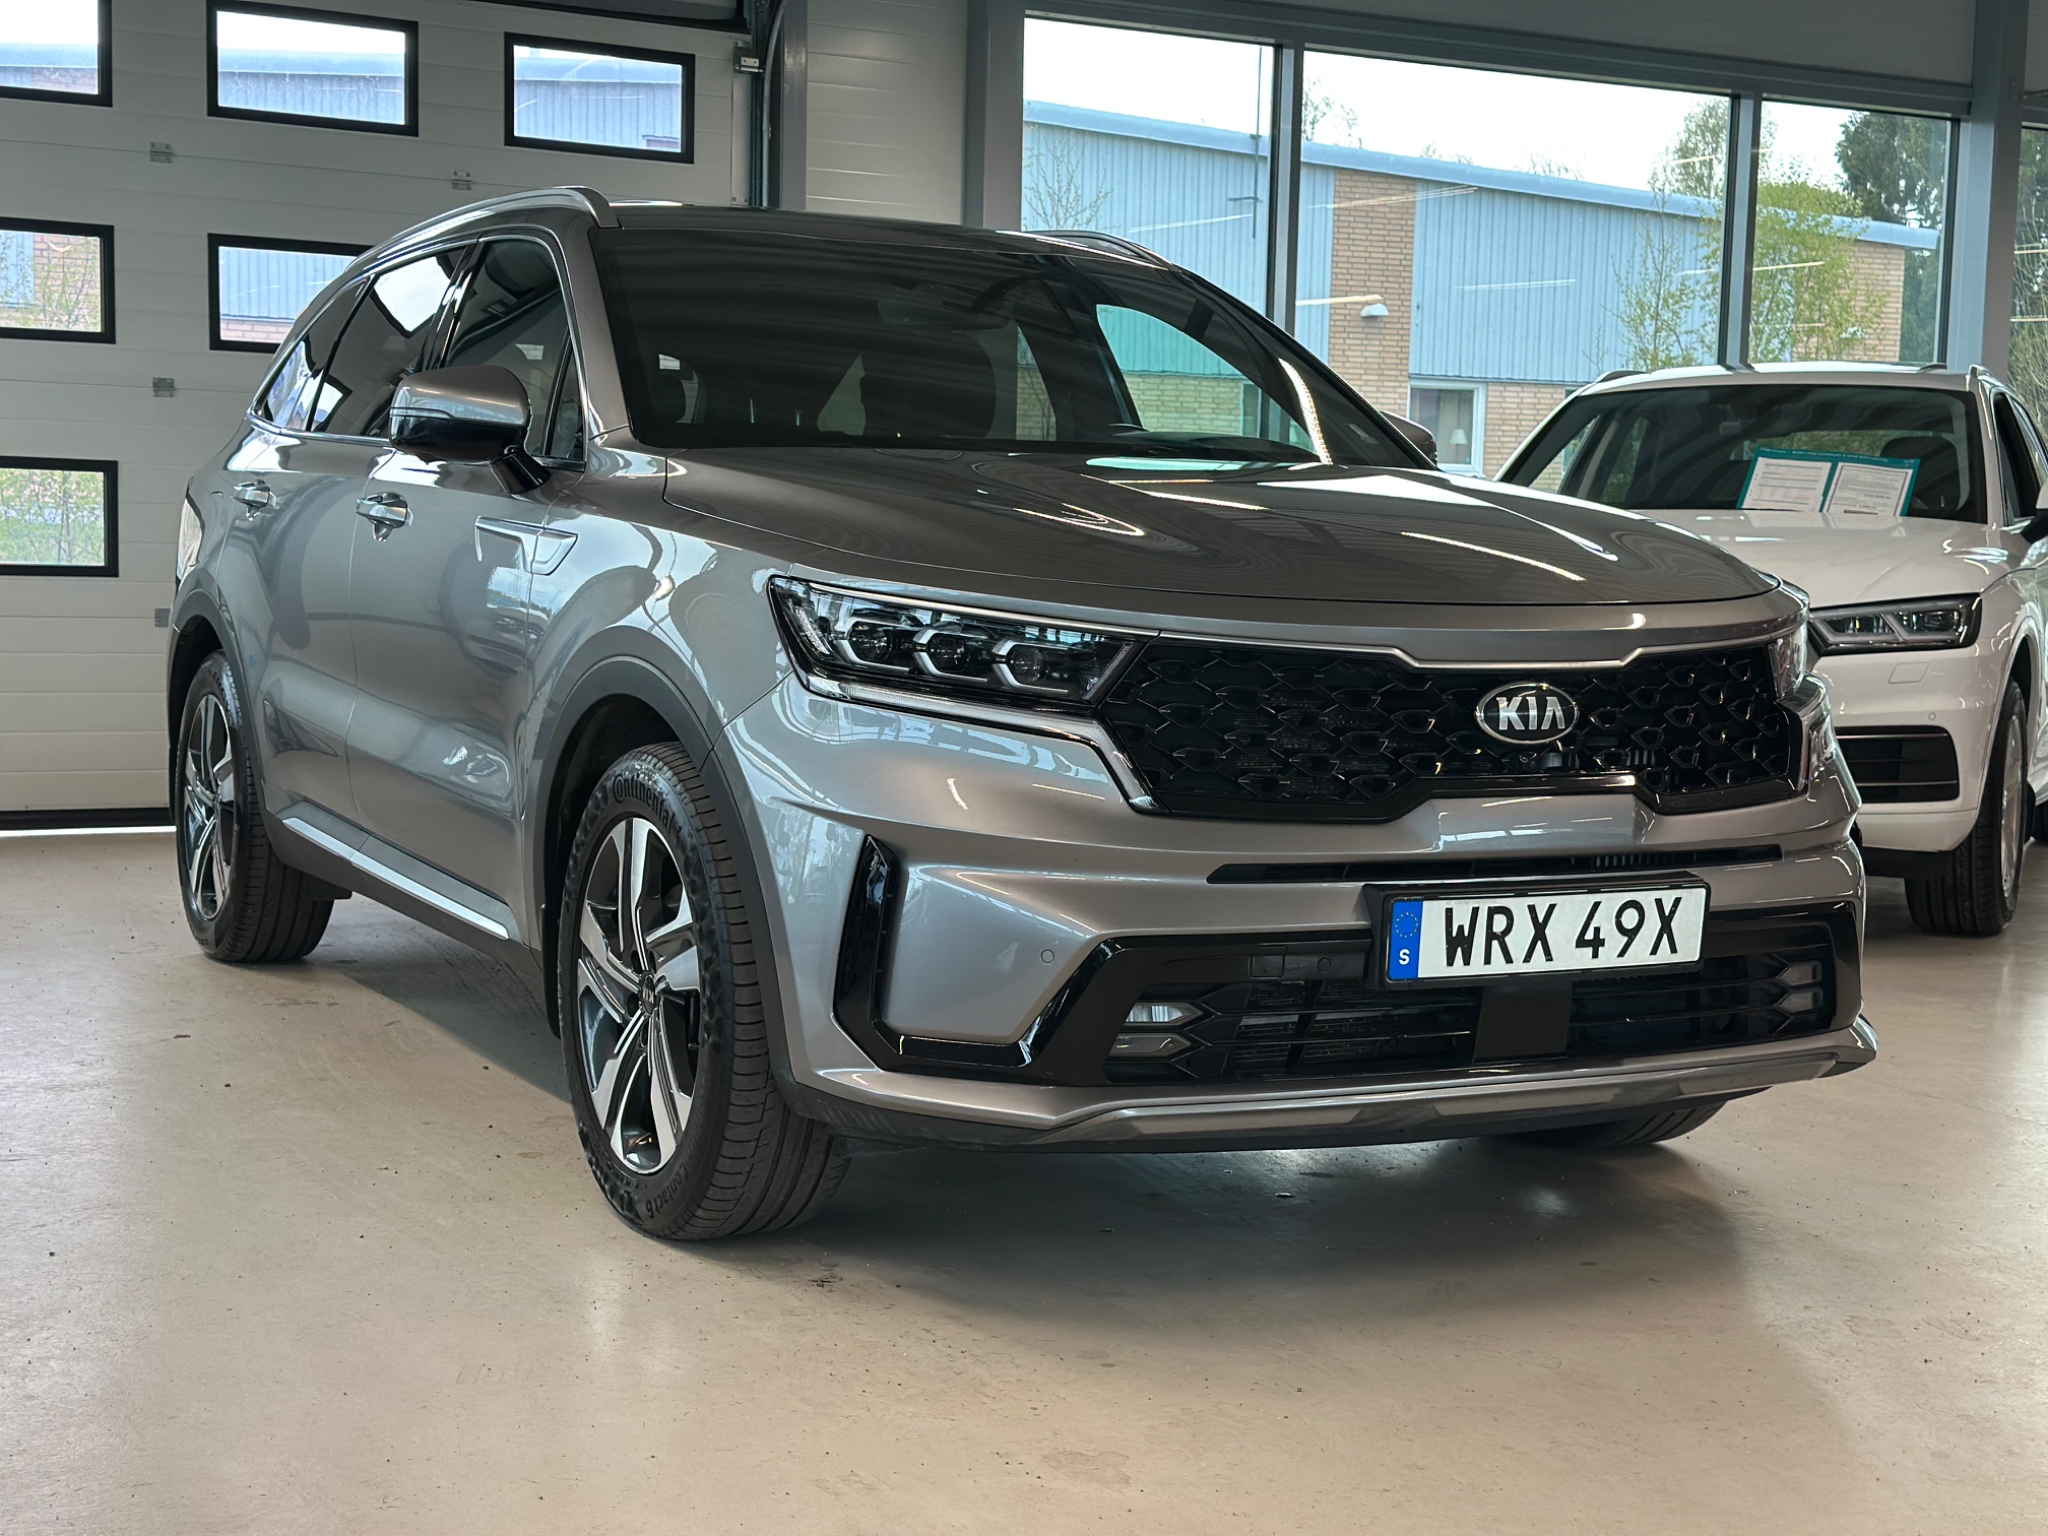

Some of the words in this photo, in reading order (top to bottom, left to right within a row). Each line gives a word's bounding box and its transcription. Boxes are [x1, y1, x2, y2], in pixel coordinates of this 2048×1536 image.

[1496, 696, 1566, 730] KIA
[612, 772, 676, 835] Continental
[1444, 903, 1557, 967] WRX
[1575, 896, 1683, 959] 49X
[1398, 948, 1410, 965] S
